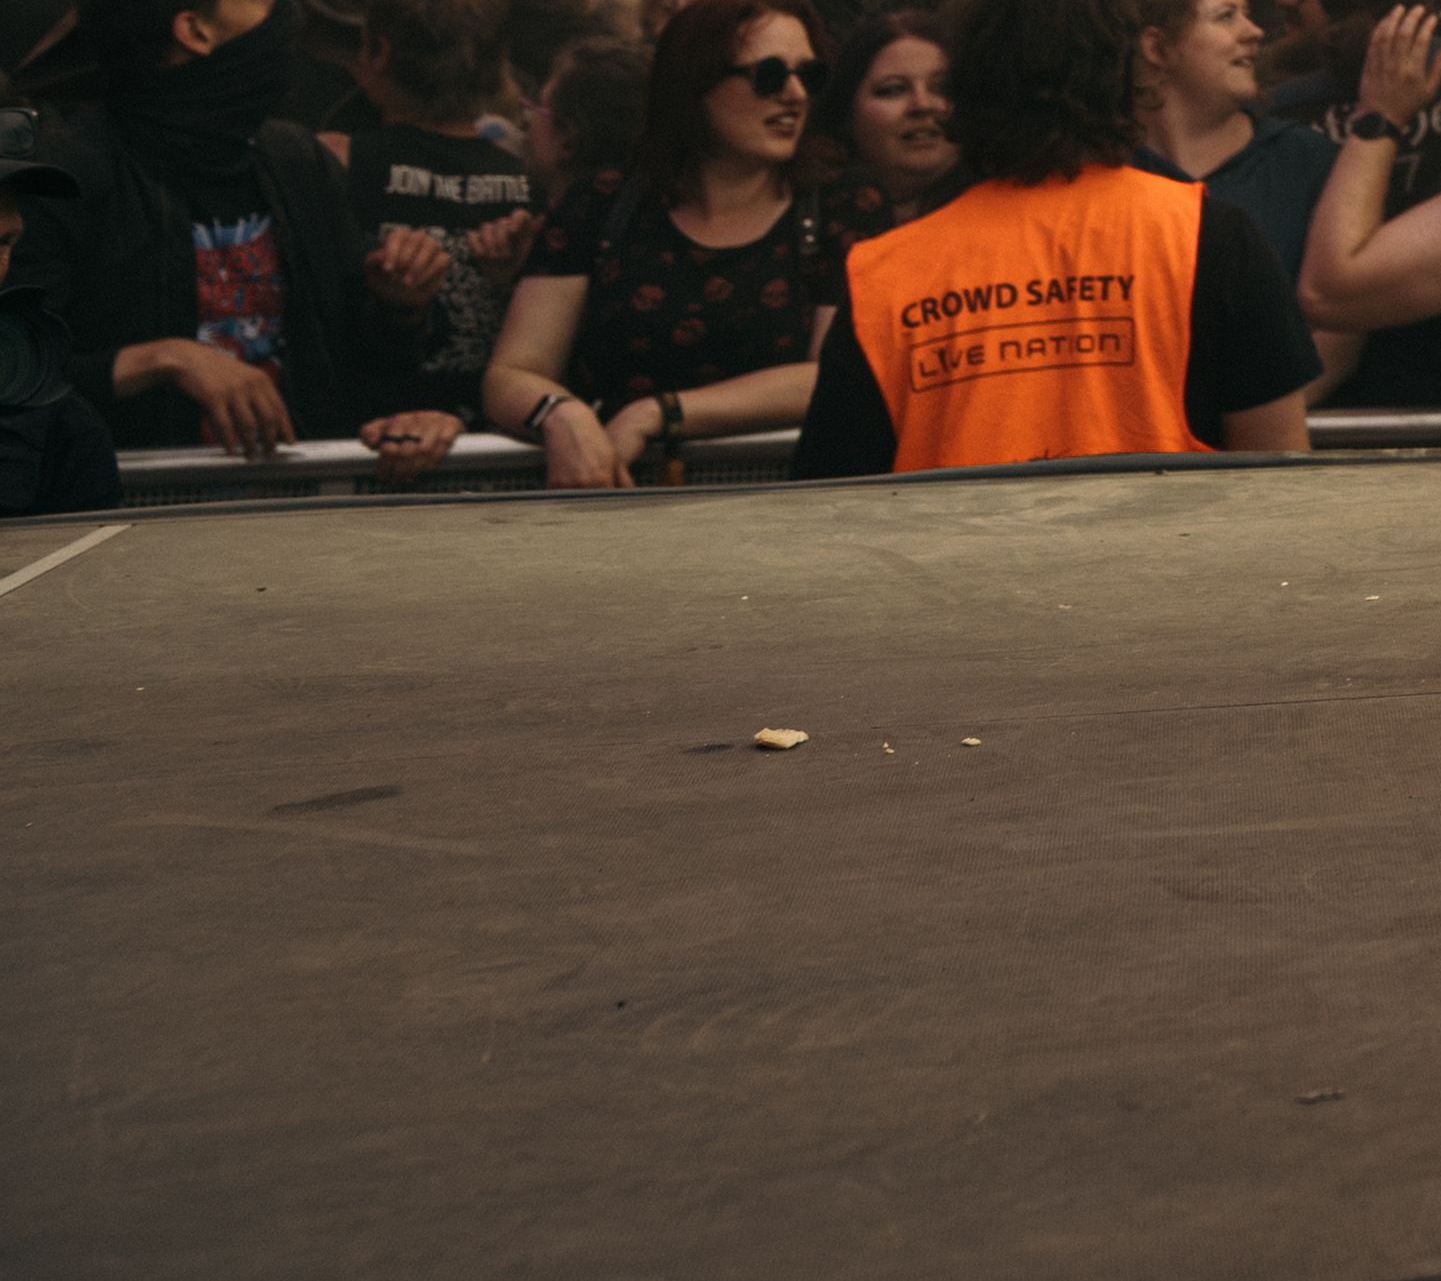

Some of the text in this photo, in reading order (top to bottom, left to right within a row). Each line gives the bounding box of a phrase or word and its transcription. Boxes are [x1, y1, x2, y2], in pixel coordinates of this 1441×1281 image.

[901, 274, 1135, 328] CROWD SAFETY
[919, 333, 1120, 377] LIVE NATION
